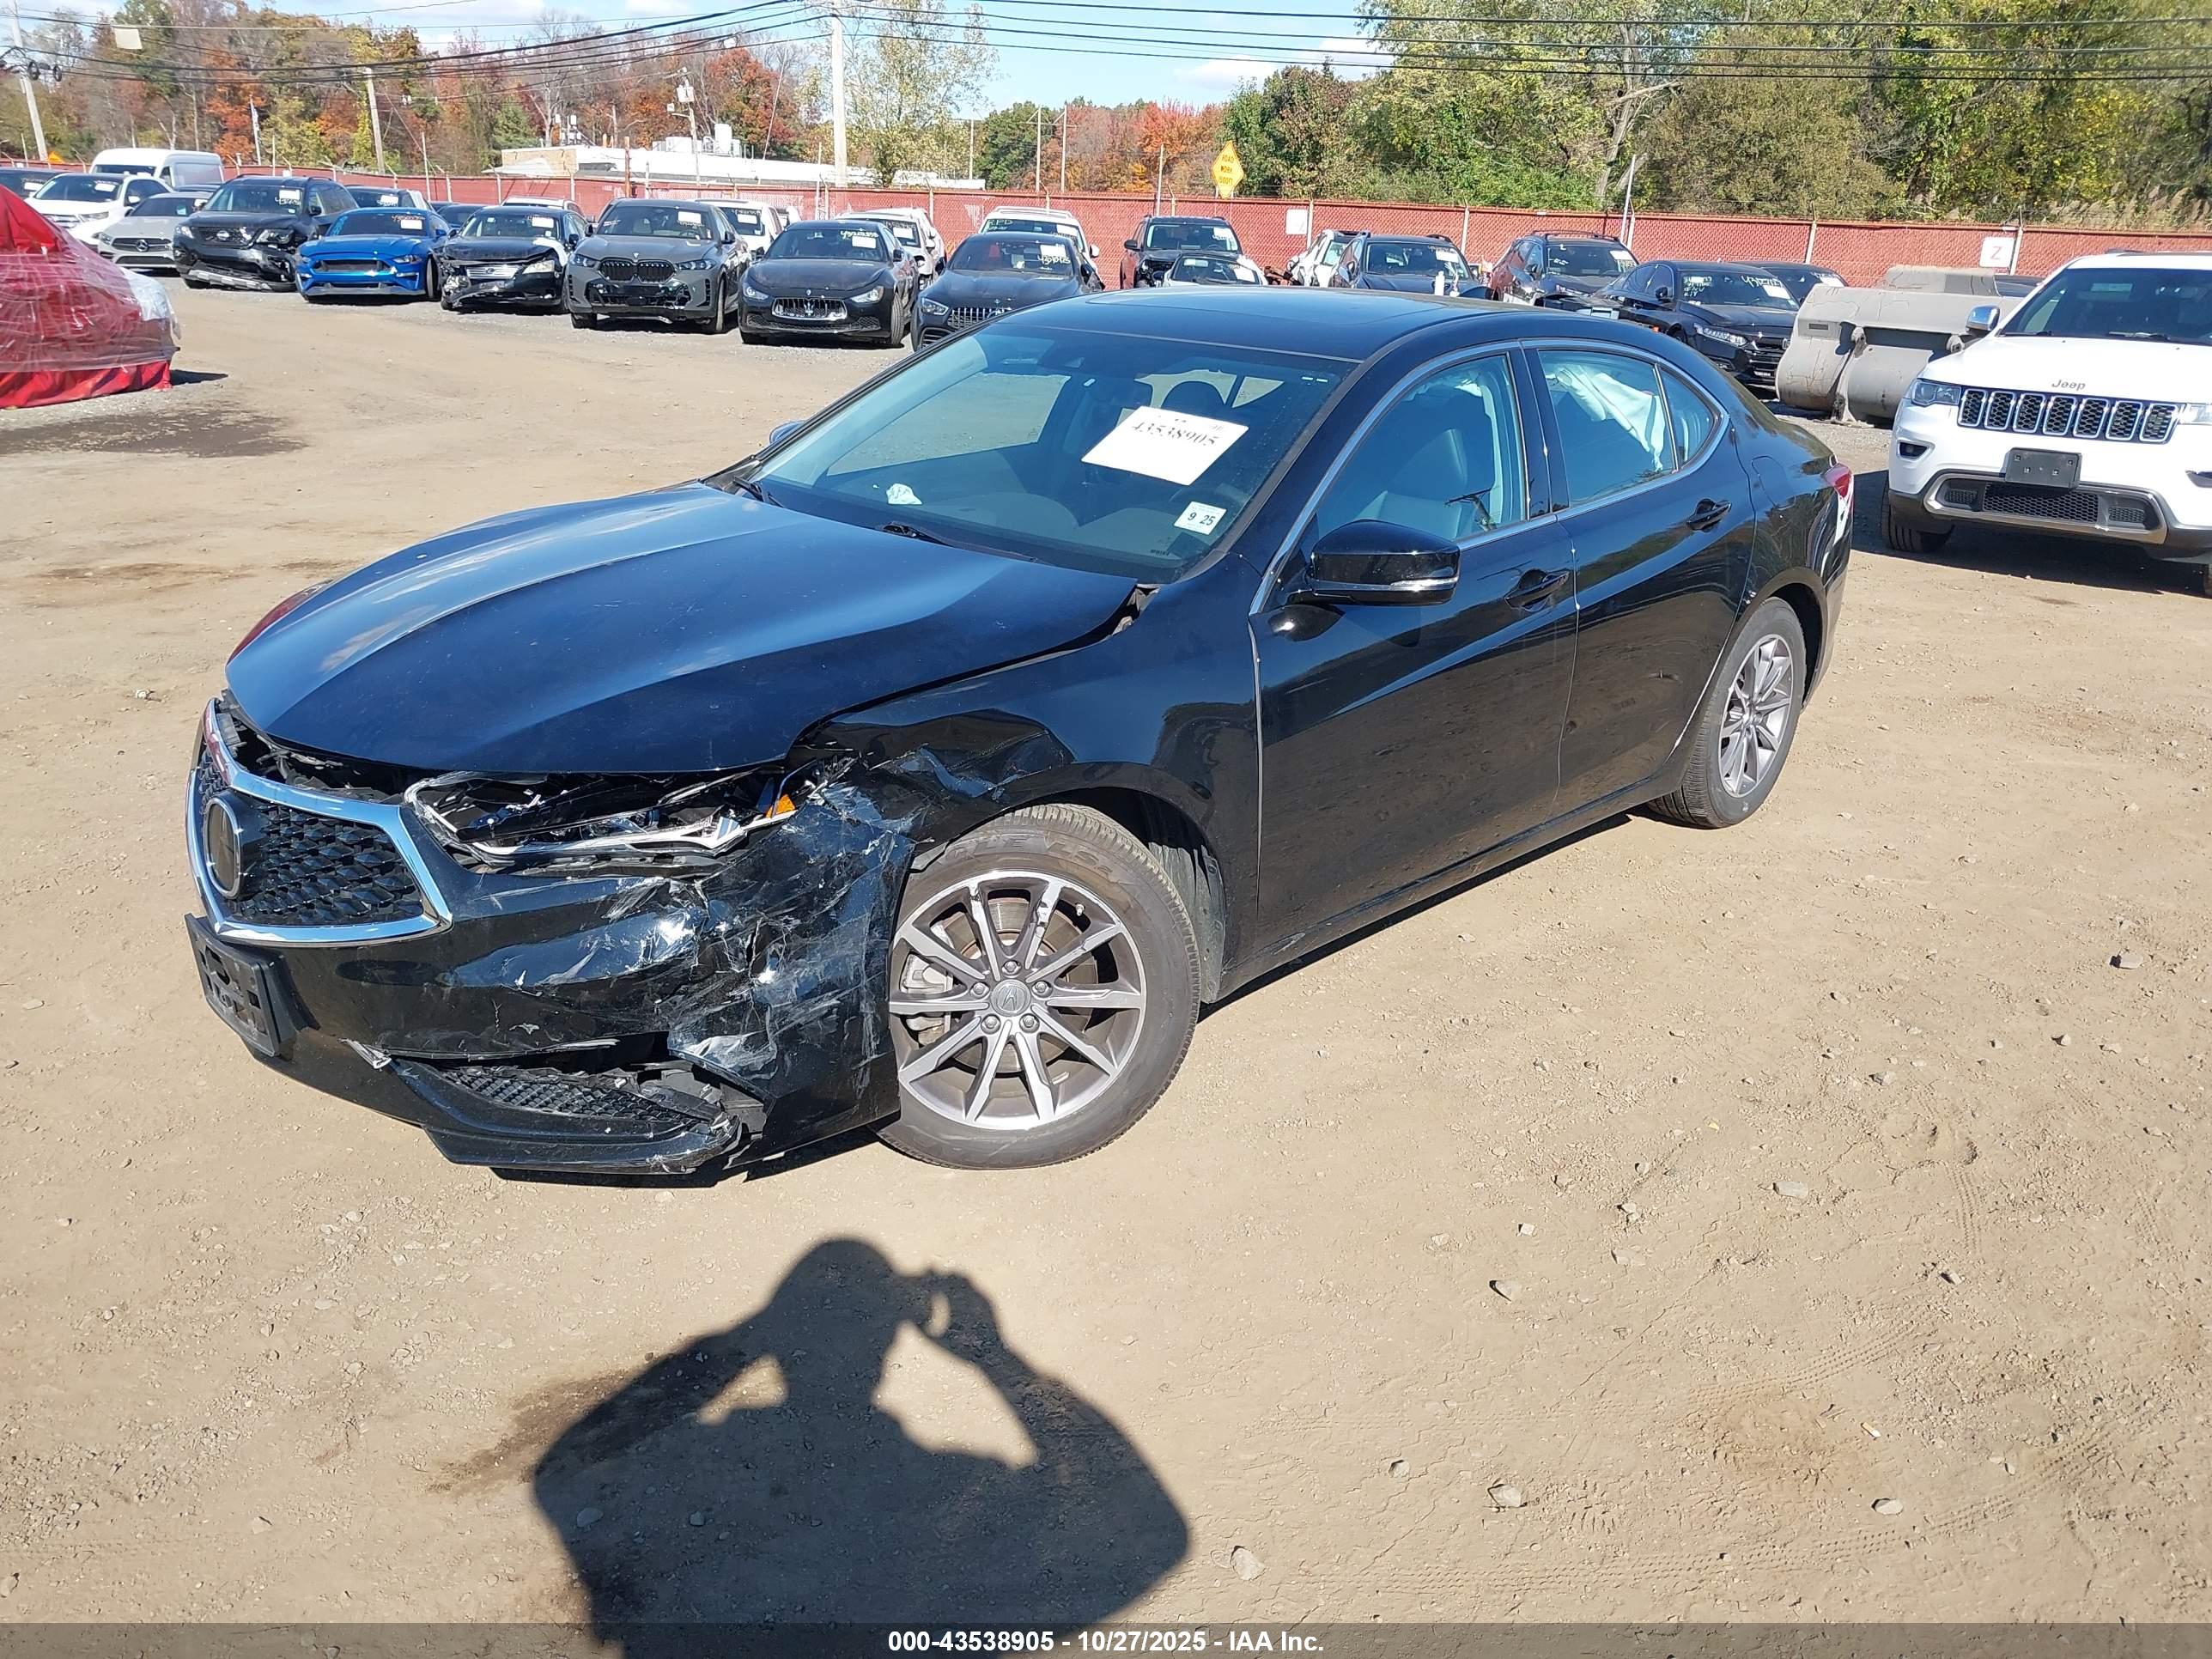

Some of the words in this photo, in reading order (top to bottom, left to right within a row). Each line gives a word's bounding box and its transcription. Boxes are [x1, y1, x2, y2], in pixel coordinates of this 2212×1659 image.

[1222, 155, 1235, 163] ROAD
[1990, 246, 2003, 260] Z
[2051, 379, 2087, 392] Jeep
[1188, 512, 1197, 521] 9
[1199, 514, 1216, 526] 25
